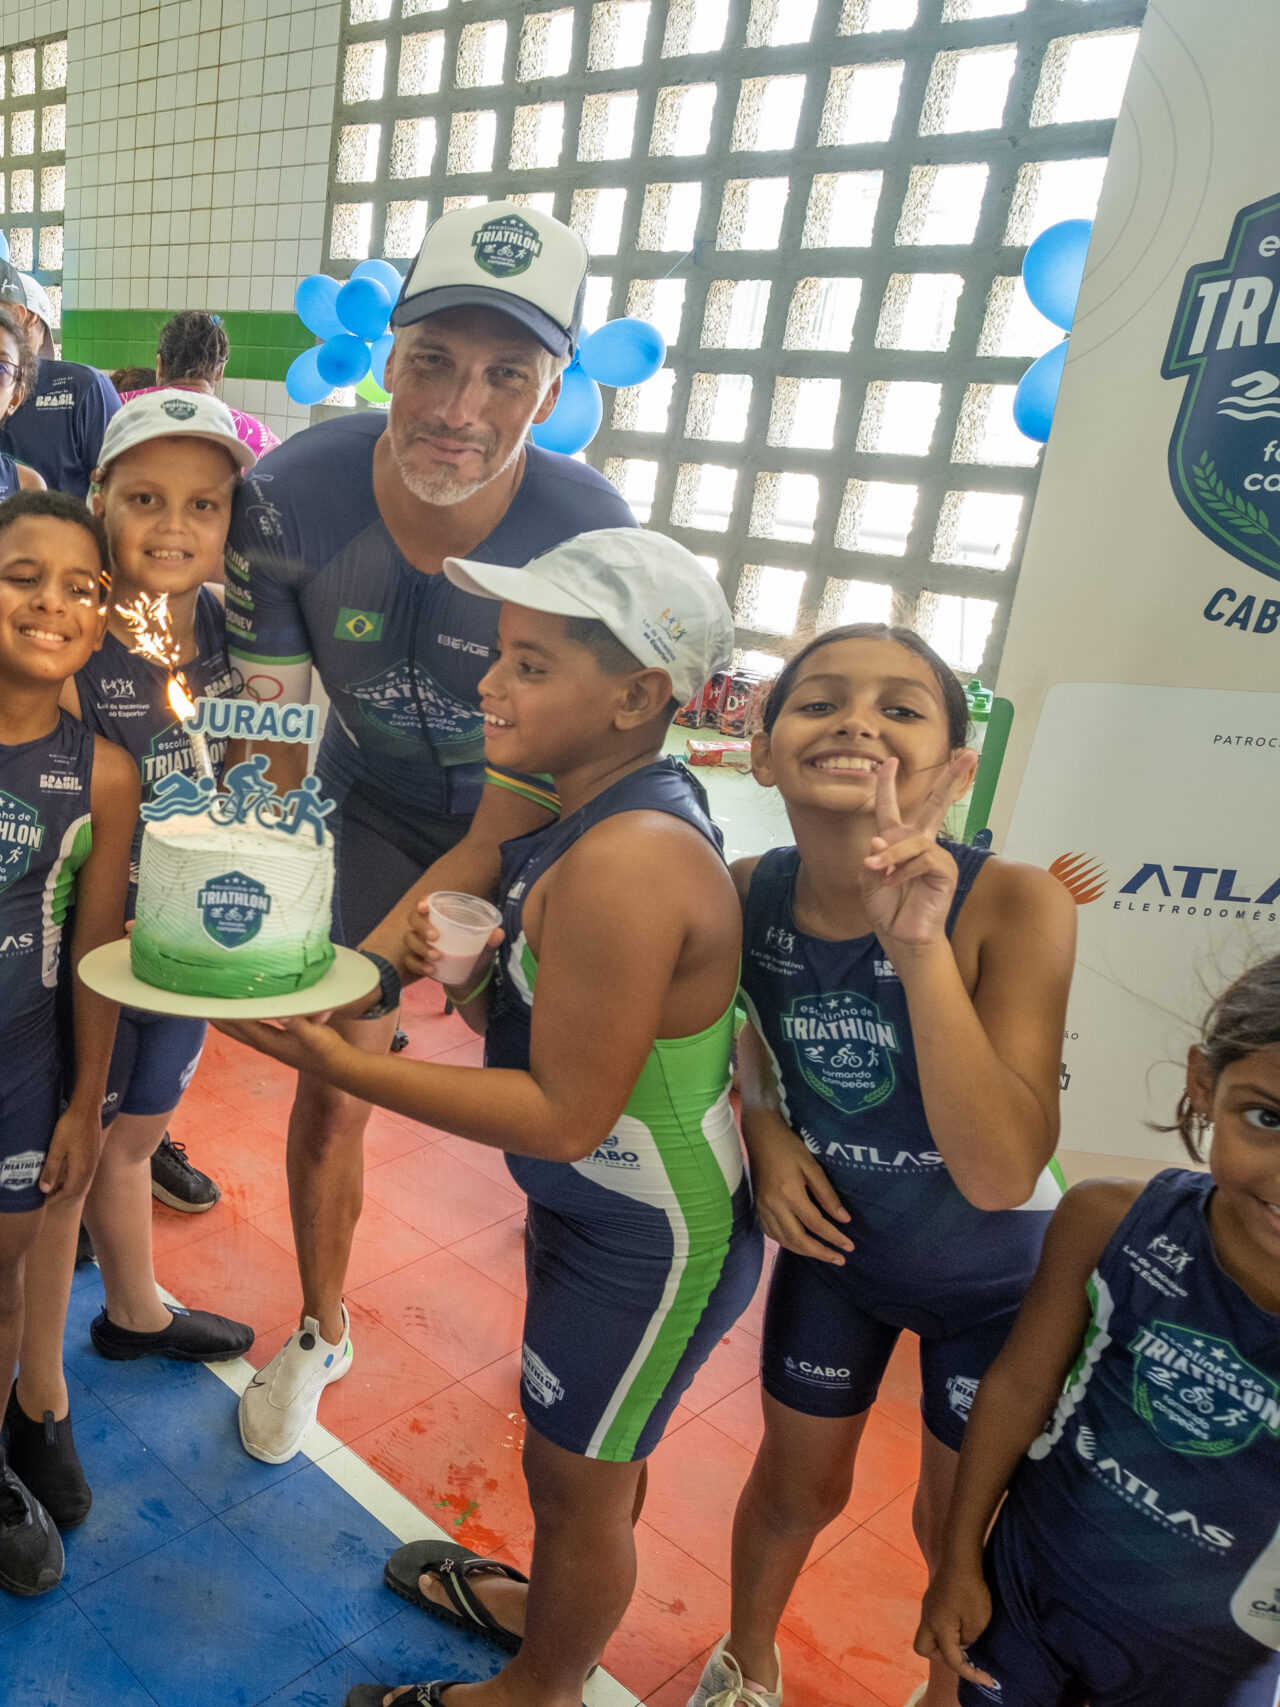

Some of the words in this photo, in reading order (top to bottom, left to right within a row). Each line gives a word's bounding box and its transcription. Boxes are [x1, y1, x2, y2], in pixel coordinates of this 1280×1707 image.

[476, 231, 540, 255] TRIATHLON
[35, 393, 75, 407] BRASIL
[1204, 588, 1280, 634] CAB
[187, 701, 314, 738] JURACI
[1213, 734, 1280, 748] PATROC
[39, 773, 83, 791] BRASIL
[18, 812, 31, 822] de
[201, 890, 269, 911] TRIATHLON
[1113, 900, 1277, 922] ELETRODOMÉS
[860, 1007, 873, 1017] de
[783, 1017, 897, 1049] TRIATHLON
[593, 1149, 639, 1162] ABO
[825, 1141, 944, 1166] ATLAS
[799, 1361, 851, 1378] CABO
[1133, 1330, 1280, 1430] TRIATHLON
[1096, 1457, 1236, 1548] ATLAS
